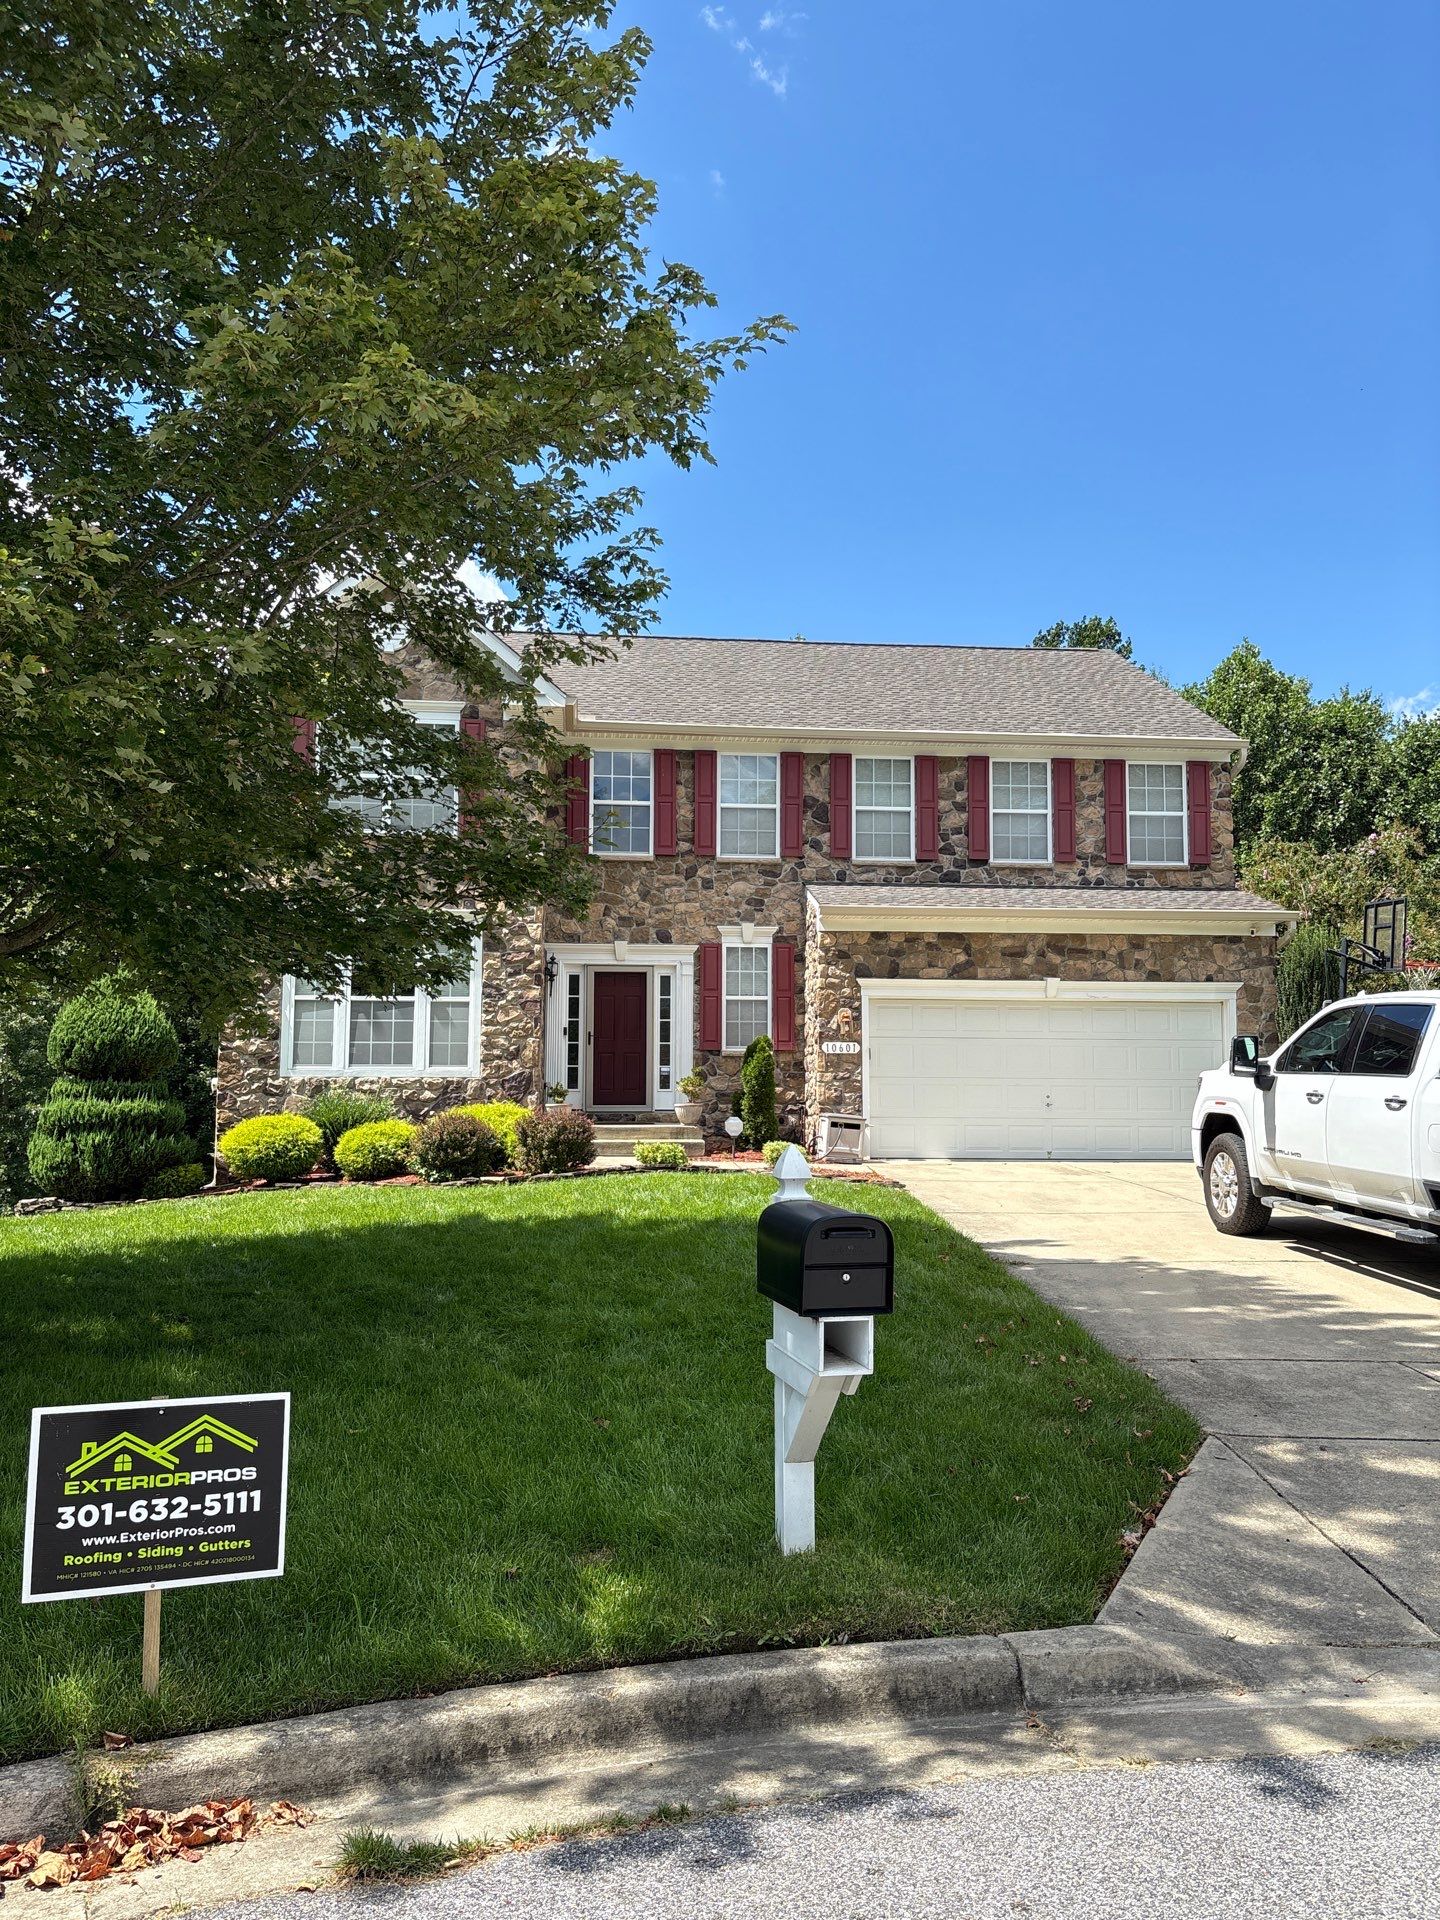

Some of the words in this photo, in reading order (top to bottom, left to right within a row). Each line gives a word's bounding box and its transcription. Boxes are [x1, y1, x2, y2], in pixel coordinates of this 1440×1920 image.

[825, 1043, 856, 1053] 10601
[55, 1489, 262, 1530] 301-632-5111
[81, 1523, 236, 1547] www.ExteriorPros.com
[63, 1551, 122, 1566] Roofing
[137, 1545, 184, 1559] Siding
[198, 1539, 252, 1553] Gutters
[56, 1573, 79, 1581] MHIC#
[193, 1559, 209, 1567] HIC#
